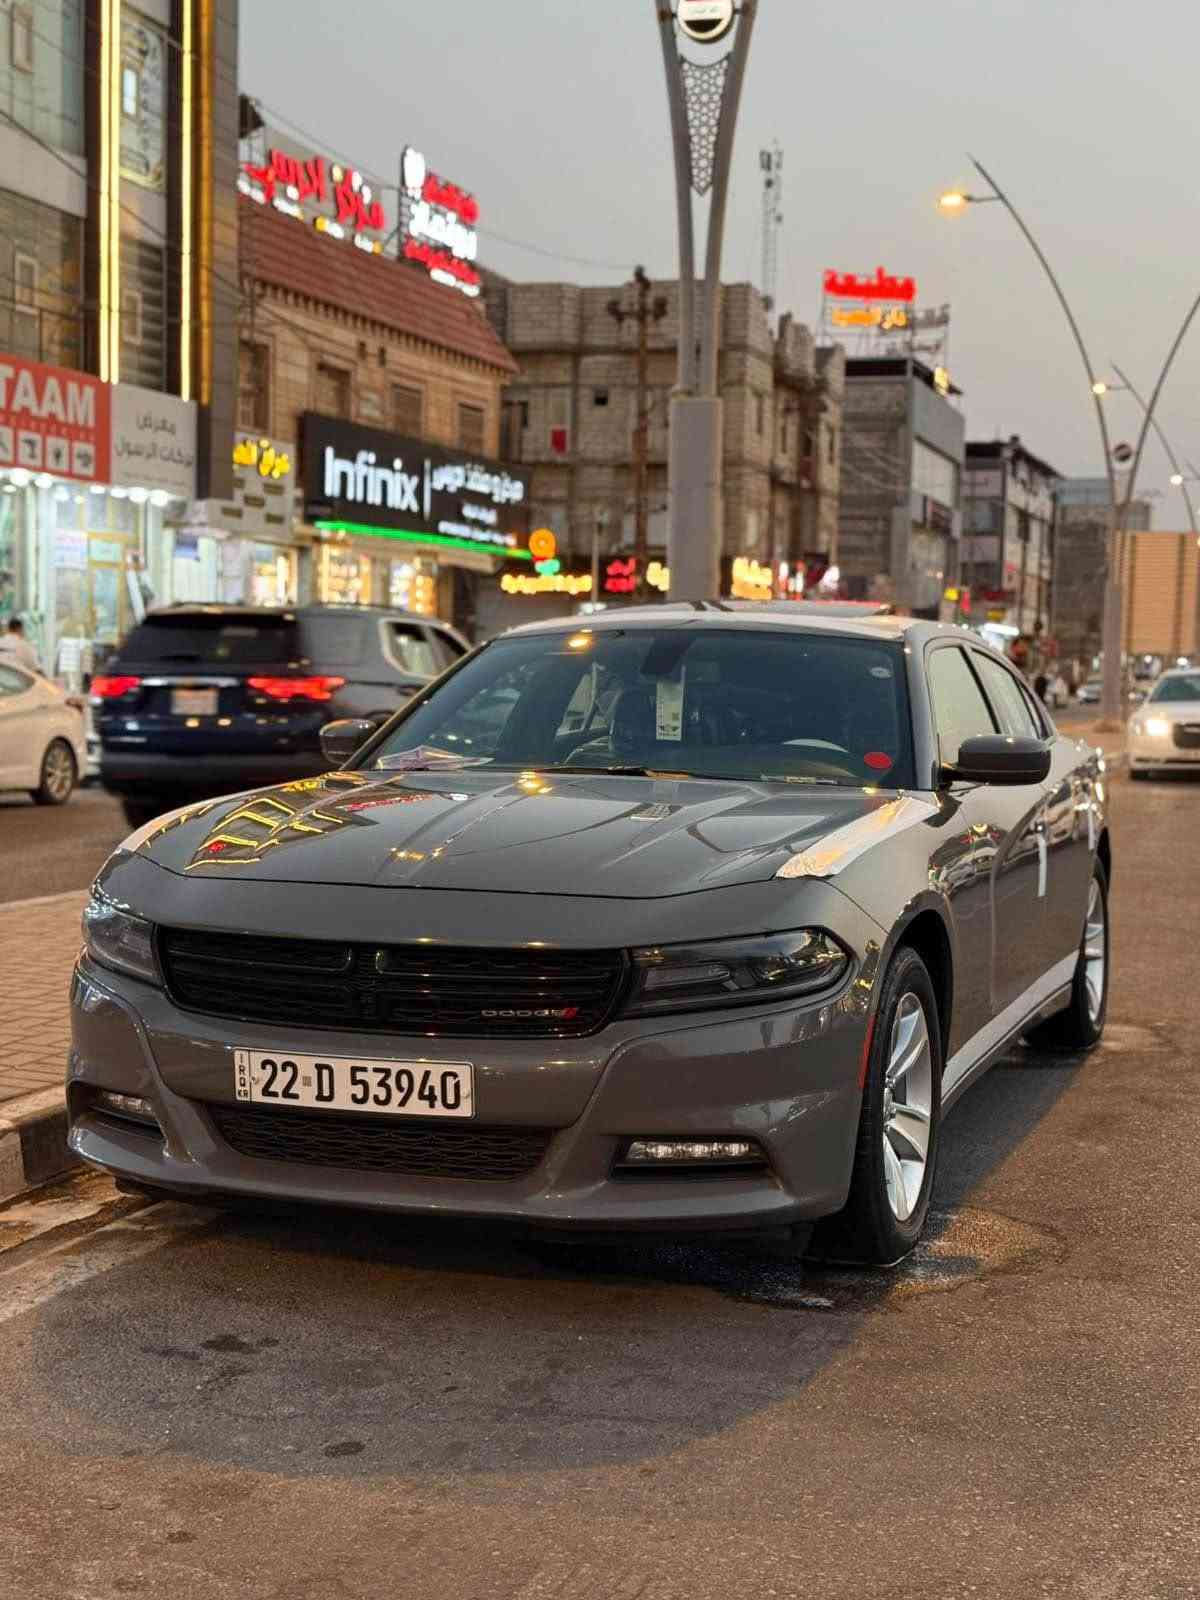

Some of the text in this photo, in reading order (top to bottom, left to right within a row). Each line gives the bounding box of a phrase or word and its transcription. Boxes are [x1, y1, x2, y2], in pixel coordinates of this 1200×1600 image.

[323, 445, 420, 514] Infinix
[260, 1058, 461, 1110] 22 D 53940
